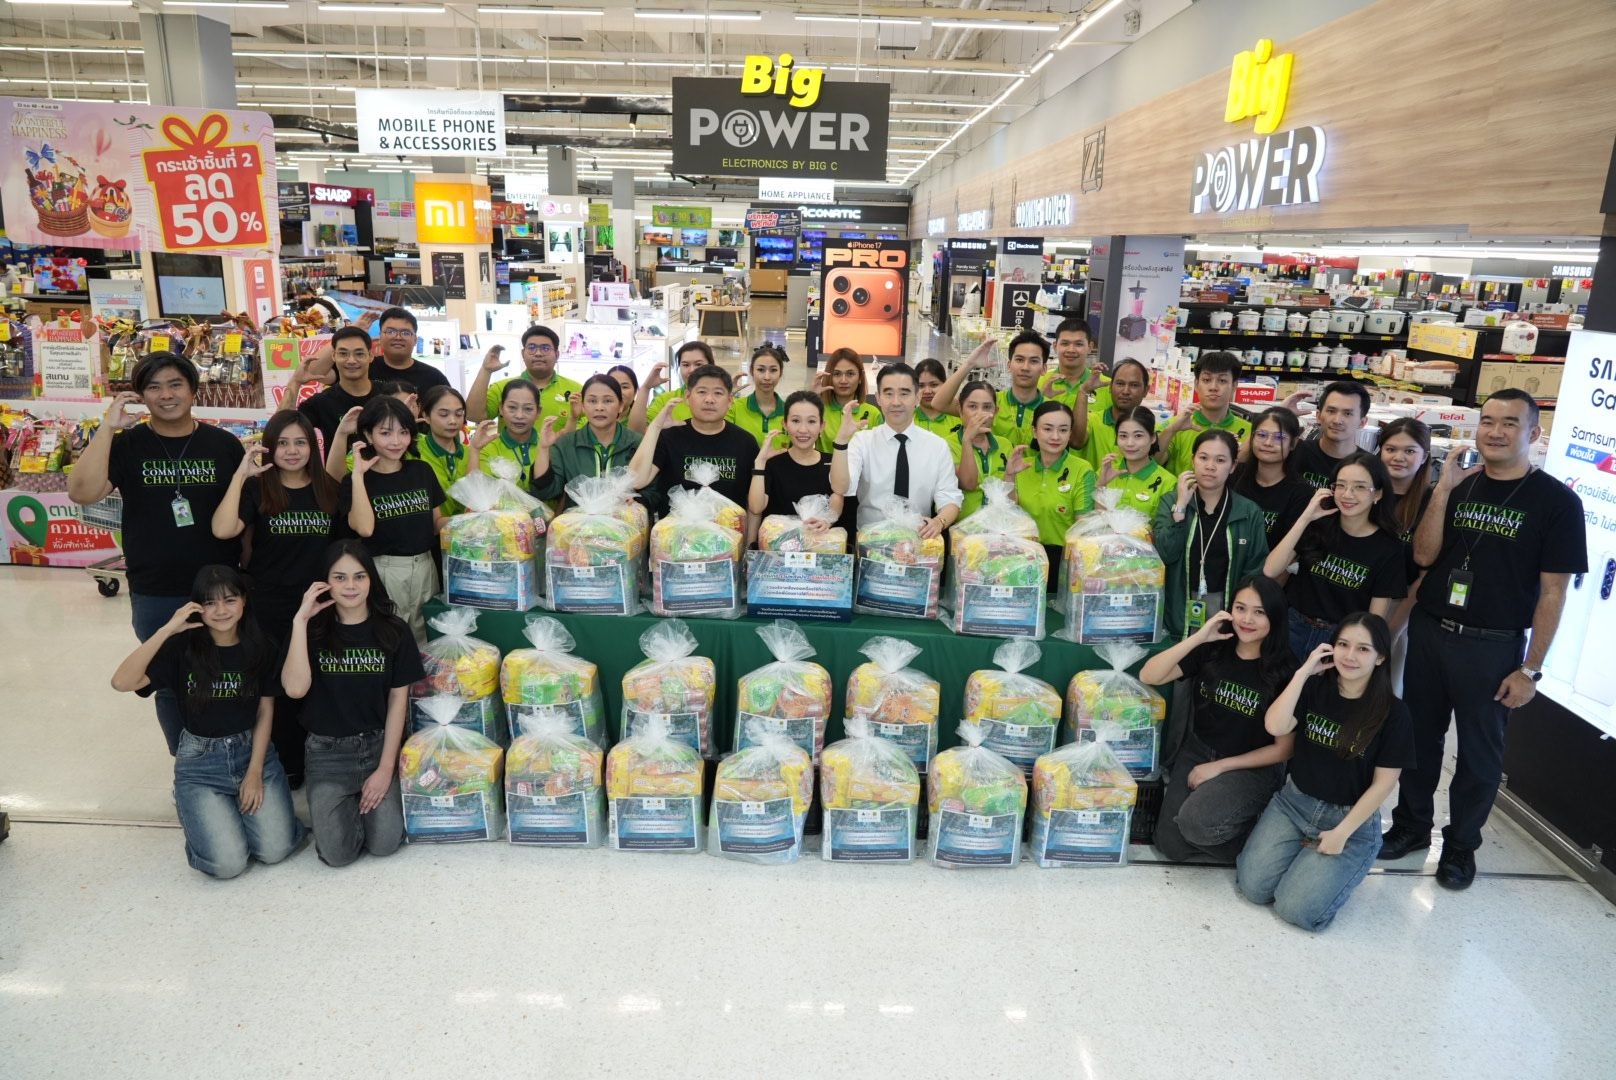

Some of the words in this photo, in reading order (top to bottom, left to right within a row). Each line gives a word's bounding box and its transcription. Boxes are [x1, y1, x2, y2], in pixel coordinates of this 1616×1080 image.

[741, 53, 824, 107] Big
[1224, 38, 1294, 134] Big
[11, 125, 68, 139] HAPPINESS
[378, 118, 437, 132] MOBILE
[443, 119, 496, 133] PHONE
[690, 108, 870, 152] POWER
[379, 137, 390, 149] &
[394, 136, 497, 151] ACCESSORIES
[156, 148, 237, 172] กระเช้าชิ้นที่
[242, 152, 253, 167] 2
[722, 158, 788, 169] ELECTRONICS
[792, 160, 805, 169] BY
[810, 161, 827, 170] BIG
[831, 162, 838, 171] C
[1189, 126, 1327, 214] POWER
[185, 172, 234, 201] ลด
[314, 186, 352, 203] SHARP
[761, 190, 785, 199] HOME
[788, 190, 831, 201] APPLIANCE
[852, 241, 875, 249] iPhone
[951, 241, 987, 250] SAMSUNG
[825, 247, 906, 268] PRO
[1552, 265, 1593, 277] SAMSUNG
[270, 343, 283, 352] Big
[271, 342, 293, 368] C
[46, 373, 69, 381] สแกน
[1440, 412, 1465, 421] Tefal
[1571, 426, 1616, 453] Samsun
[142, 460, 216, 470] CULTIVATE
[1454, 511, 1523, 530] COMMITMENT
[1310, 564, 1362, 589] HALLENGE
[320, 663, 385, 673] CHALLENGE
